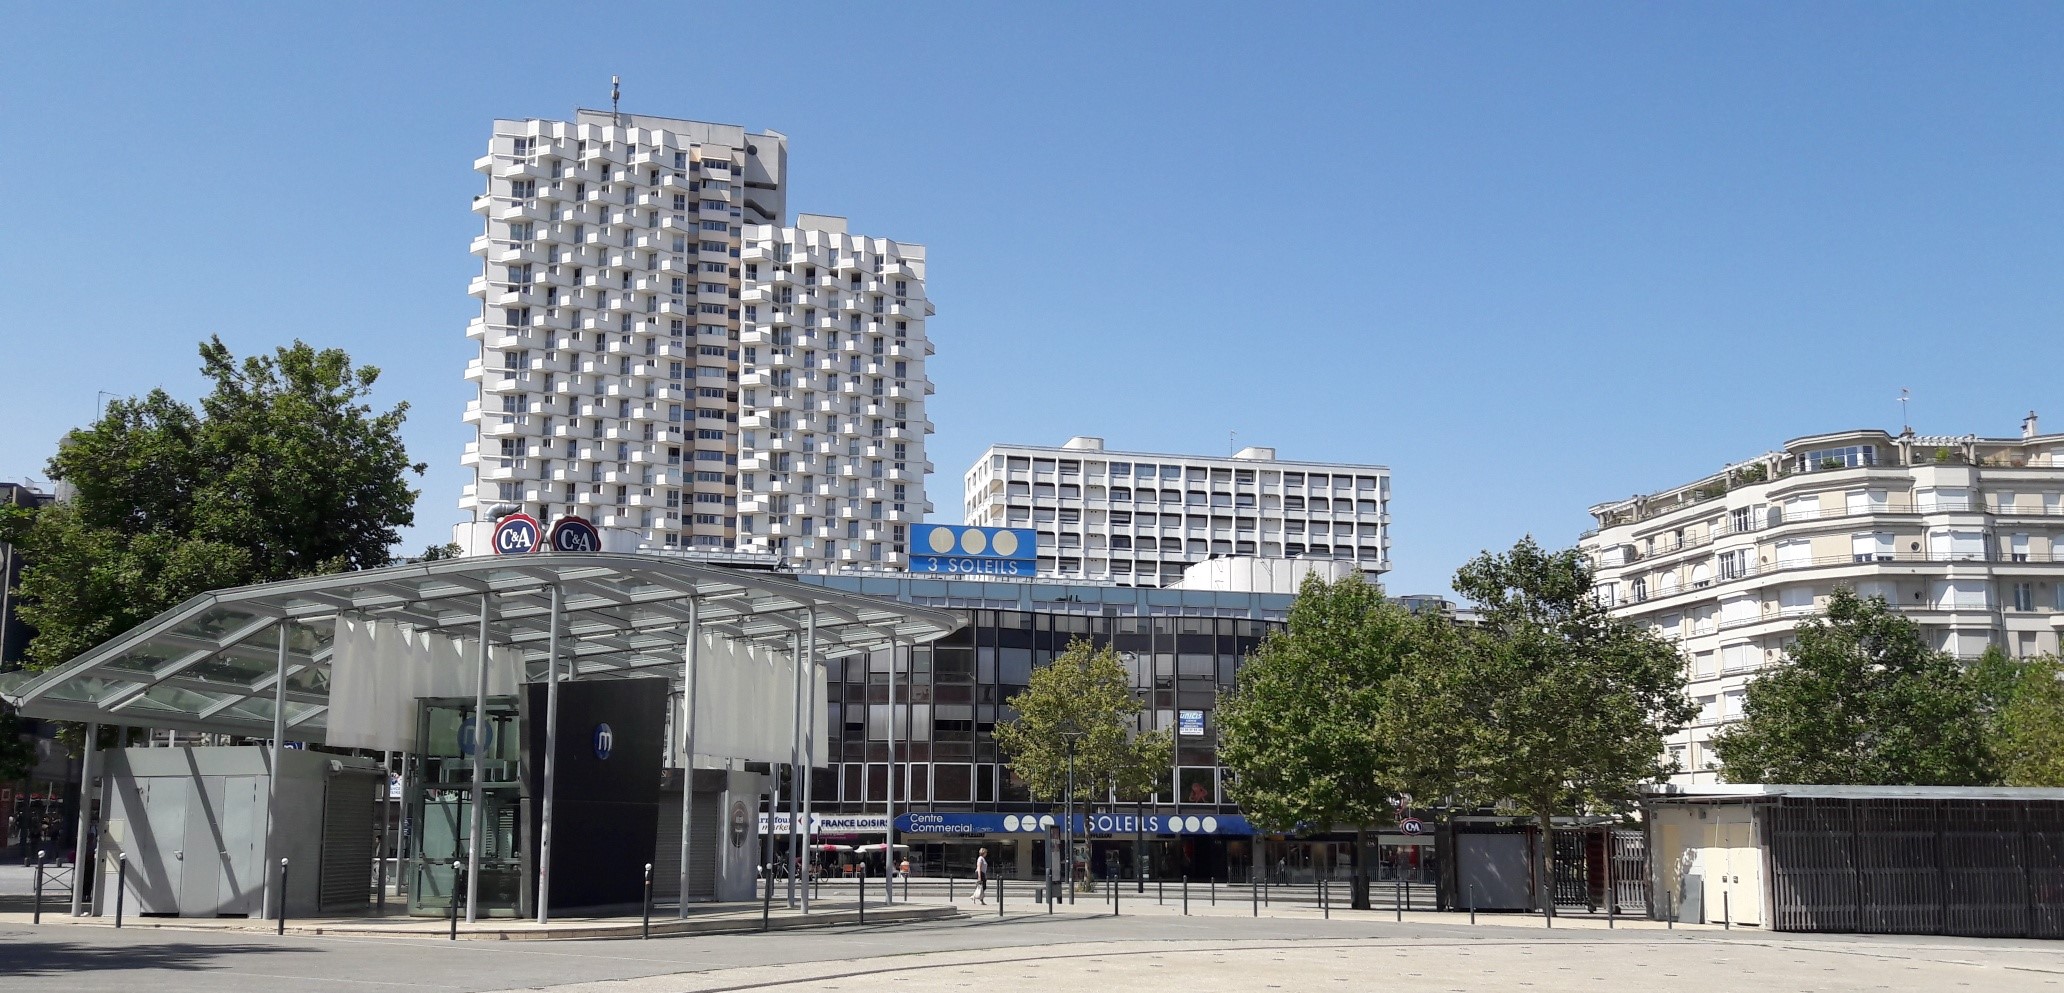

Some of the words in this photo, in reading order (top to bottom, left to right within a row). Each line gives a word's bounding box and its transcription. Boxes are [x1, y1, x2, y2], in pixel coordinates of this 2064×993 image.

[500, 526, 532, 550] C&A
[560, 529, 591, 551] C&A
[928, 557, 938, 572] 3
[948, 558, 1018, 575] SOLEILS
[598, 731, 613, 752] m
[821, 819, 855, 827] FRANCE
[910, 813, 944, 823] Centre
[1088, 815, 1159, 832] SOLEILS
[910, 823, 973, 832] Commercial
